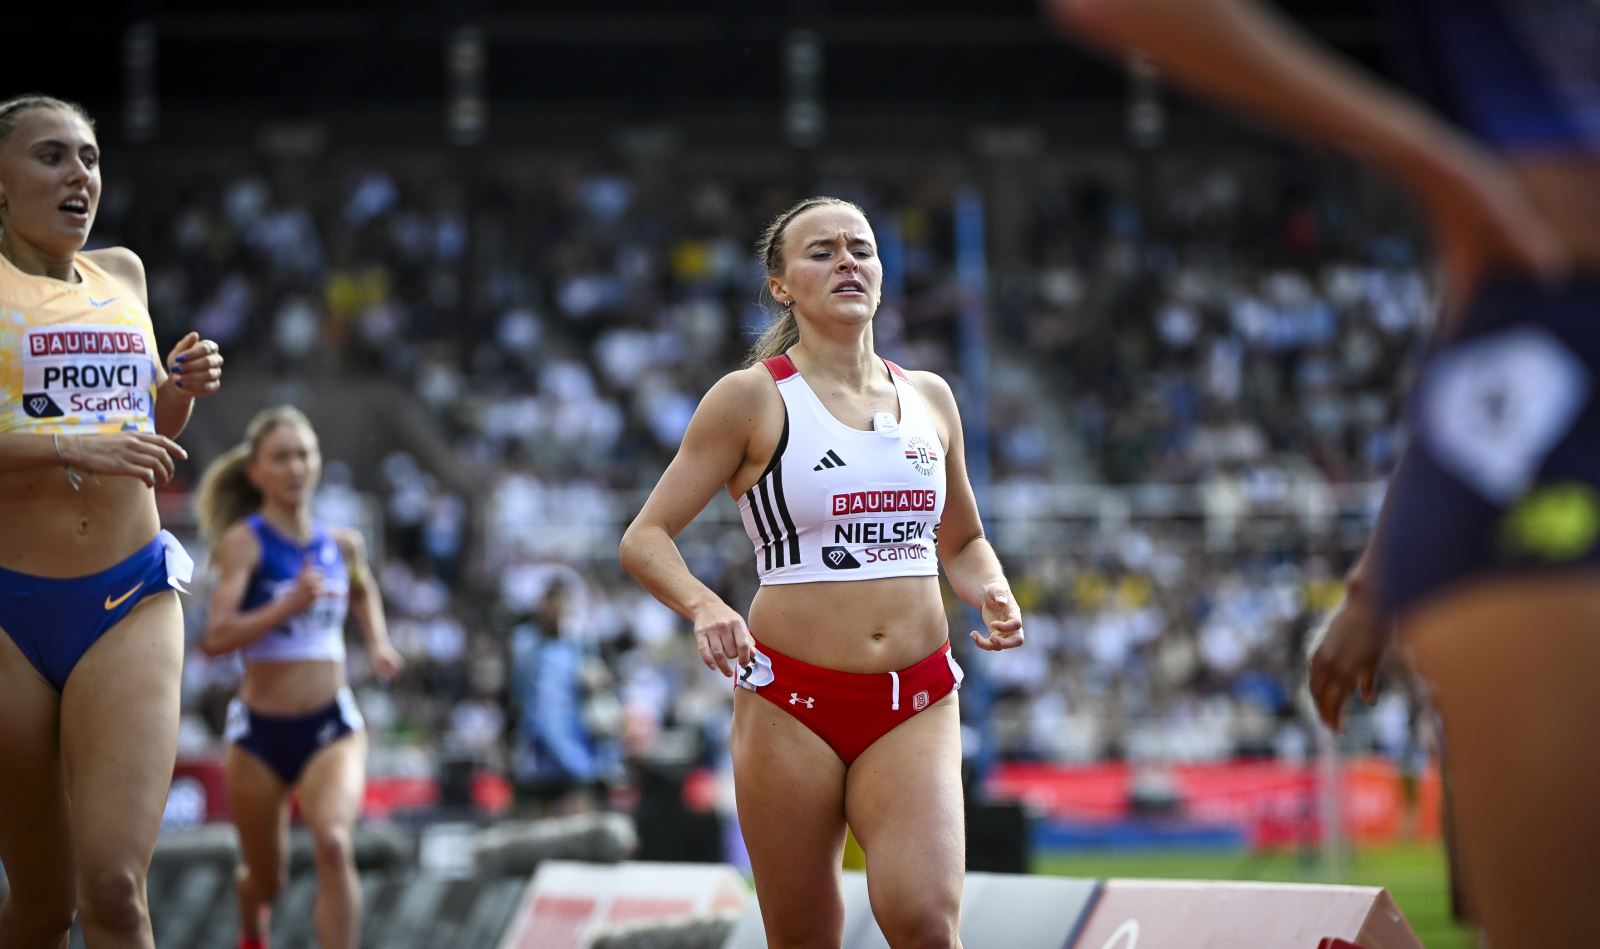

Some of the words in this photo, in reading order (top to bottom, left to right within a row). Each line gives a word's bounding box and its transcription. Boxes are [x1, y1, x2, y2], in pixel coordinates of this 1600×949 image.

[31, 332, 145, 354] BAUHAUS
[43, 365, 137, 389] PROVCI
[70, 393, 144, 412] Scandic
[834, 491, 935, 513] BAUHAUS
[834, 521, 927, 544] NIELSEN
[864, 544, 927, 563] Scandic
